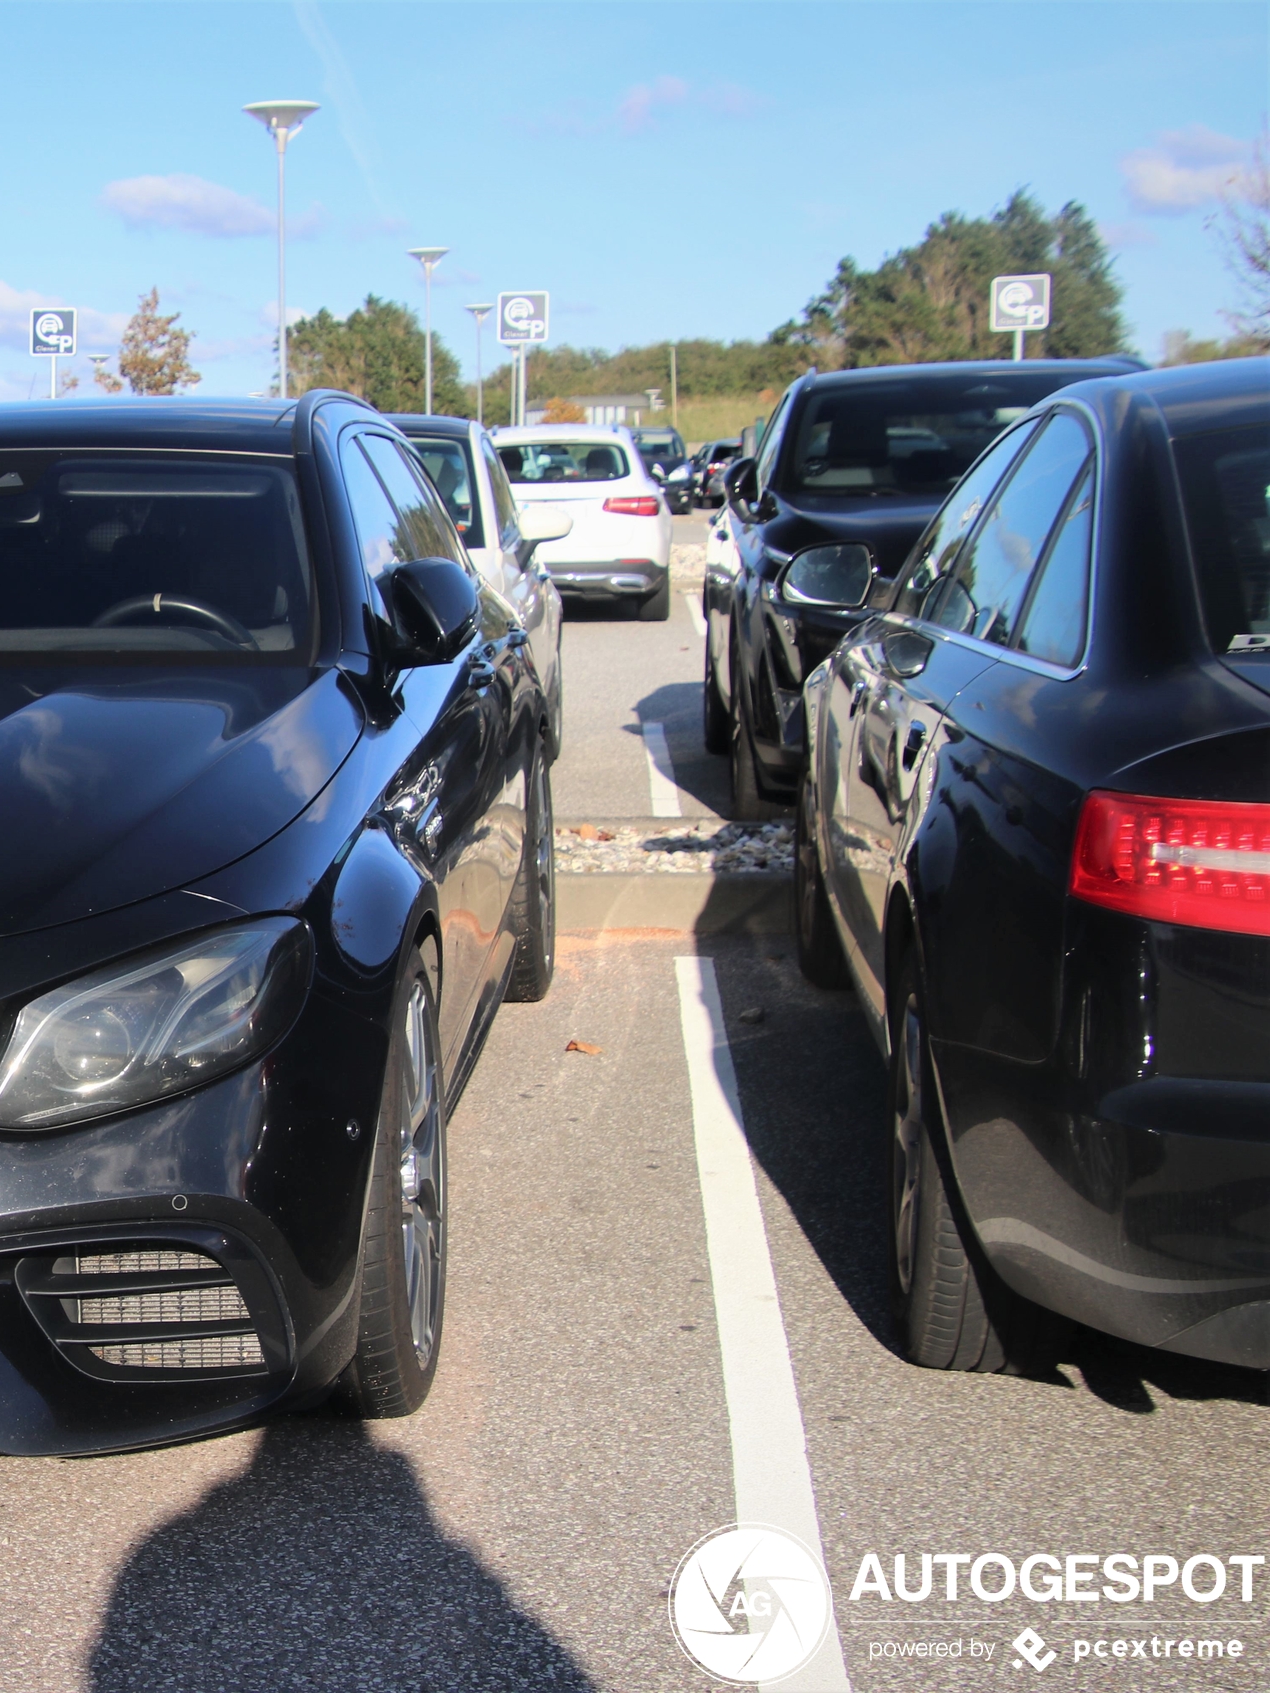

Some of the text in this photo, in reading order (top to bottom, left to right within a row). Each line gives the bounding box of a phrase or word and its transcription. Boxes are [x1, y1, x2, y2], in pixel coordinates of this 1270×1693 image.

[1027, 305, 1045, 325] P
[530, 320, 545, 339] P
[59, 335, 73, 353] P
